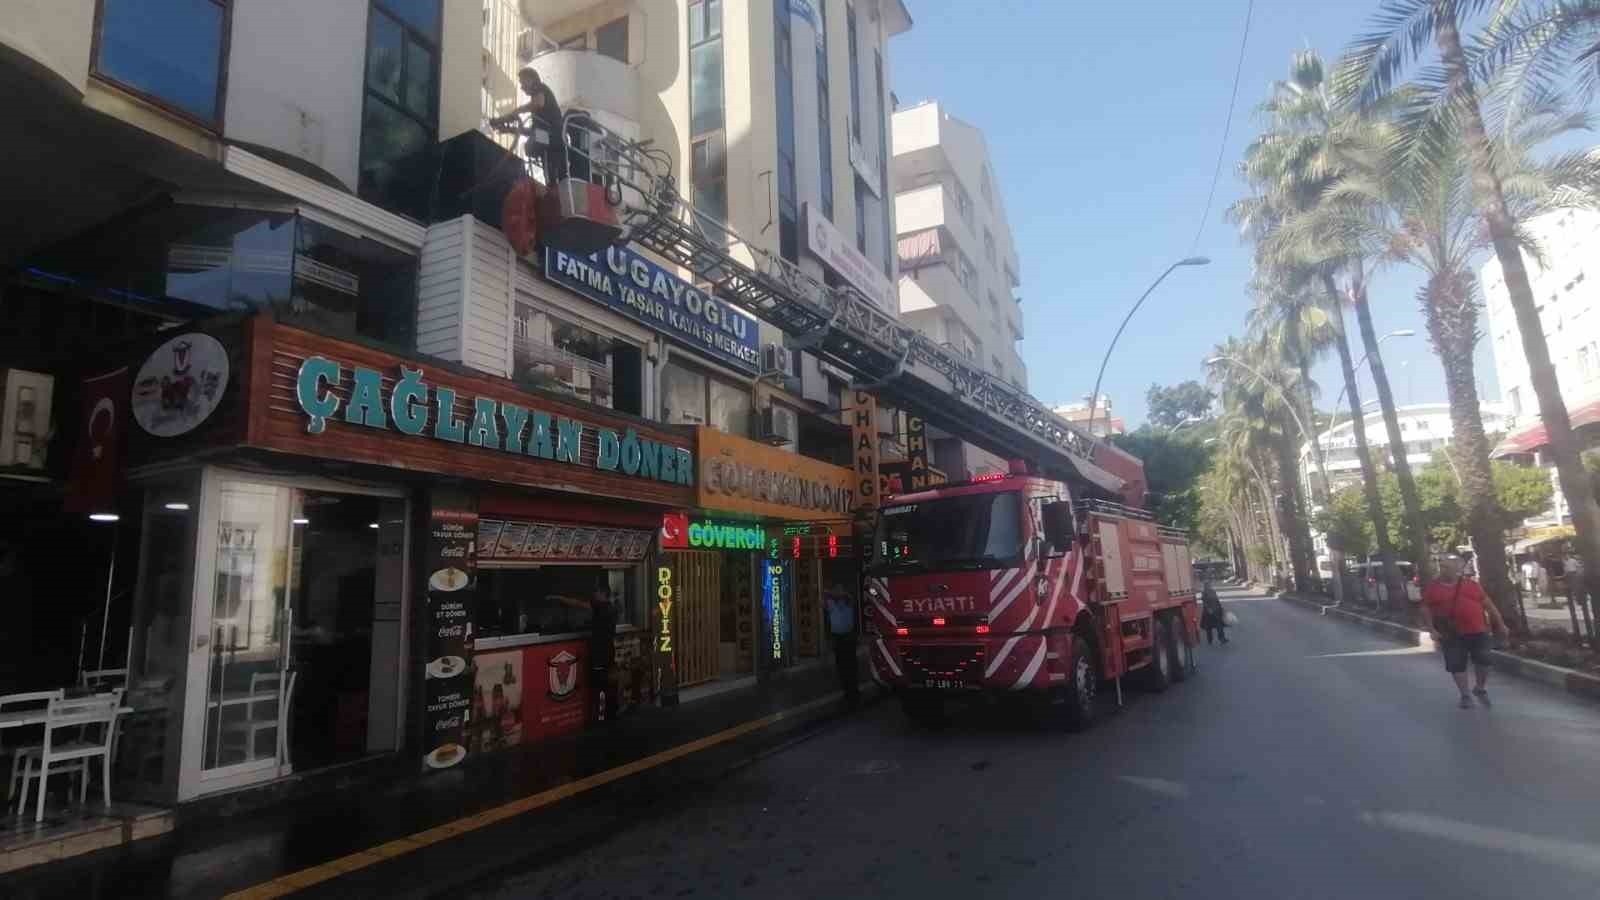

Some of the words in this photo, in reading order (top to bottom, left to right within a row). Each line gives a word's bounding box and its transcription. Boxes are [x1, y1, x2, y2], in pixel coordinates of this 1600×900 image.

[557, 251, 613, 296] FATMA
[617, 282, 665, 322] YAŞAR
[668, 308, 700, 340] KAYA
[297, 355, 583, 465] ÇAĞLAYAN
[597, 427, 693, 487] DÖNER
[768, 565, 783, 575] NO
